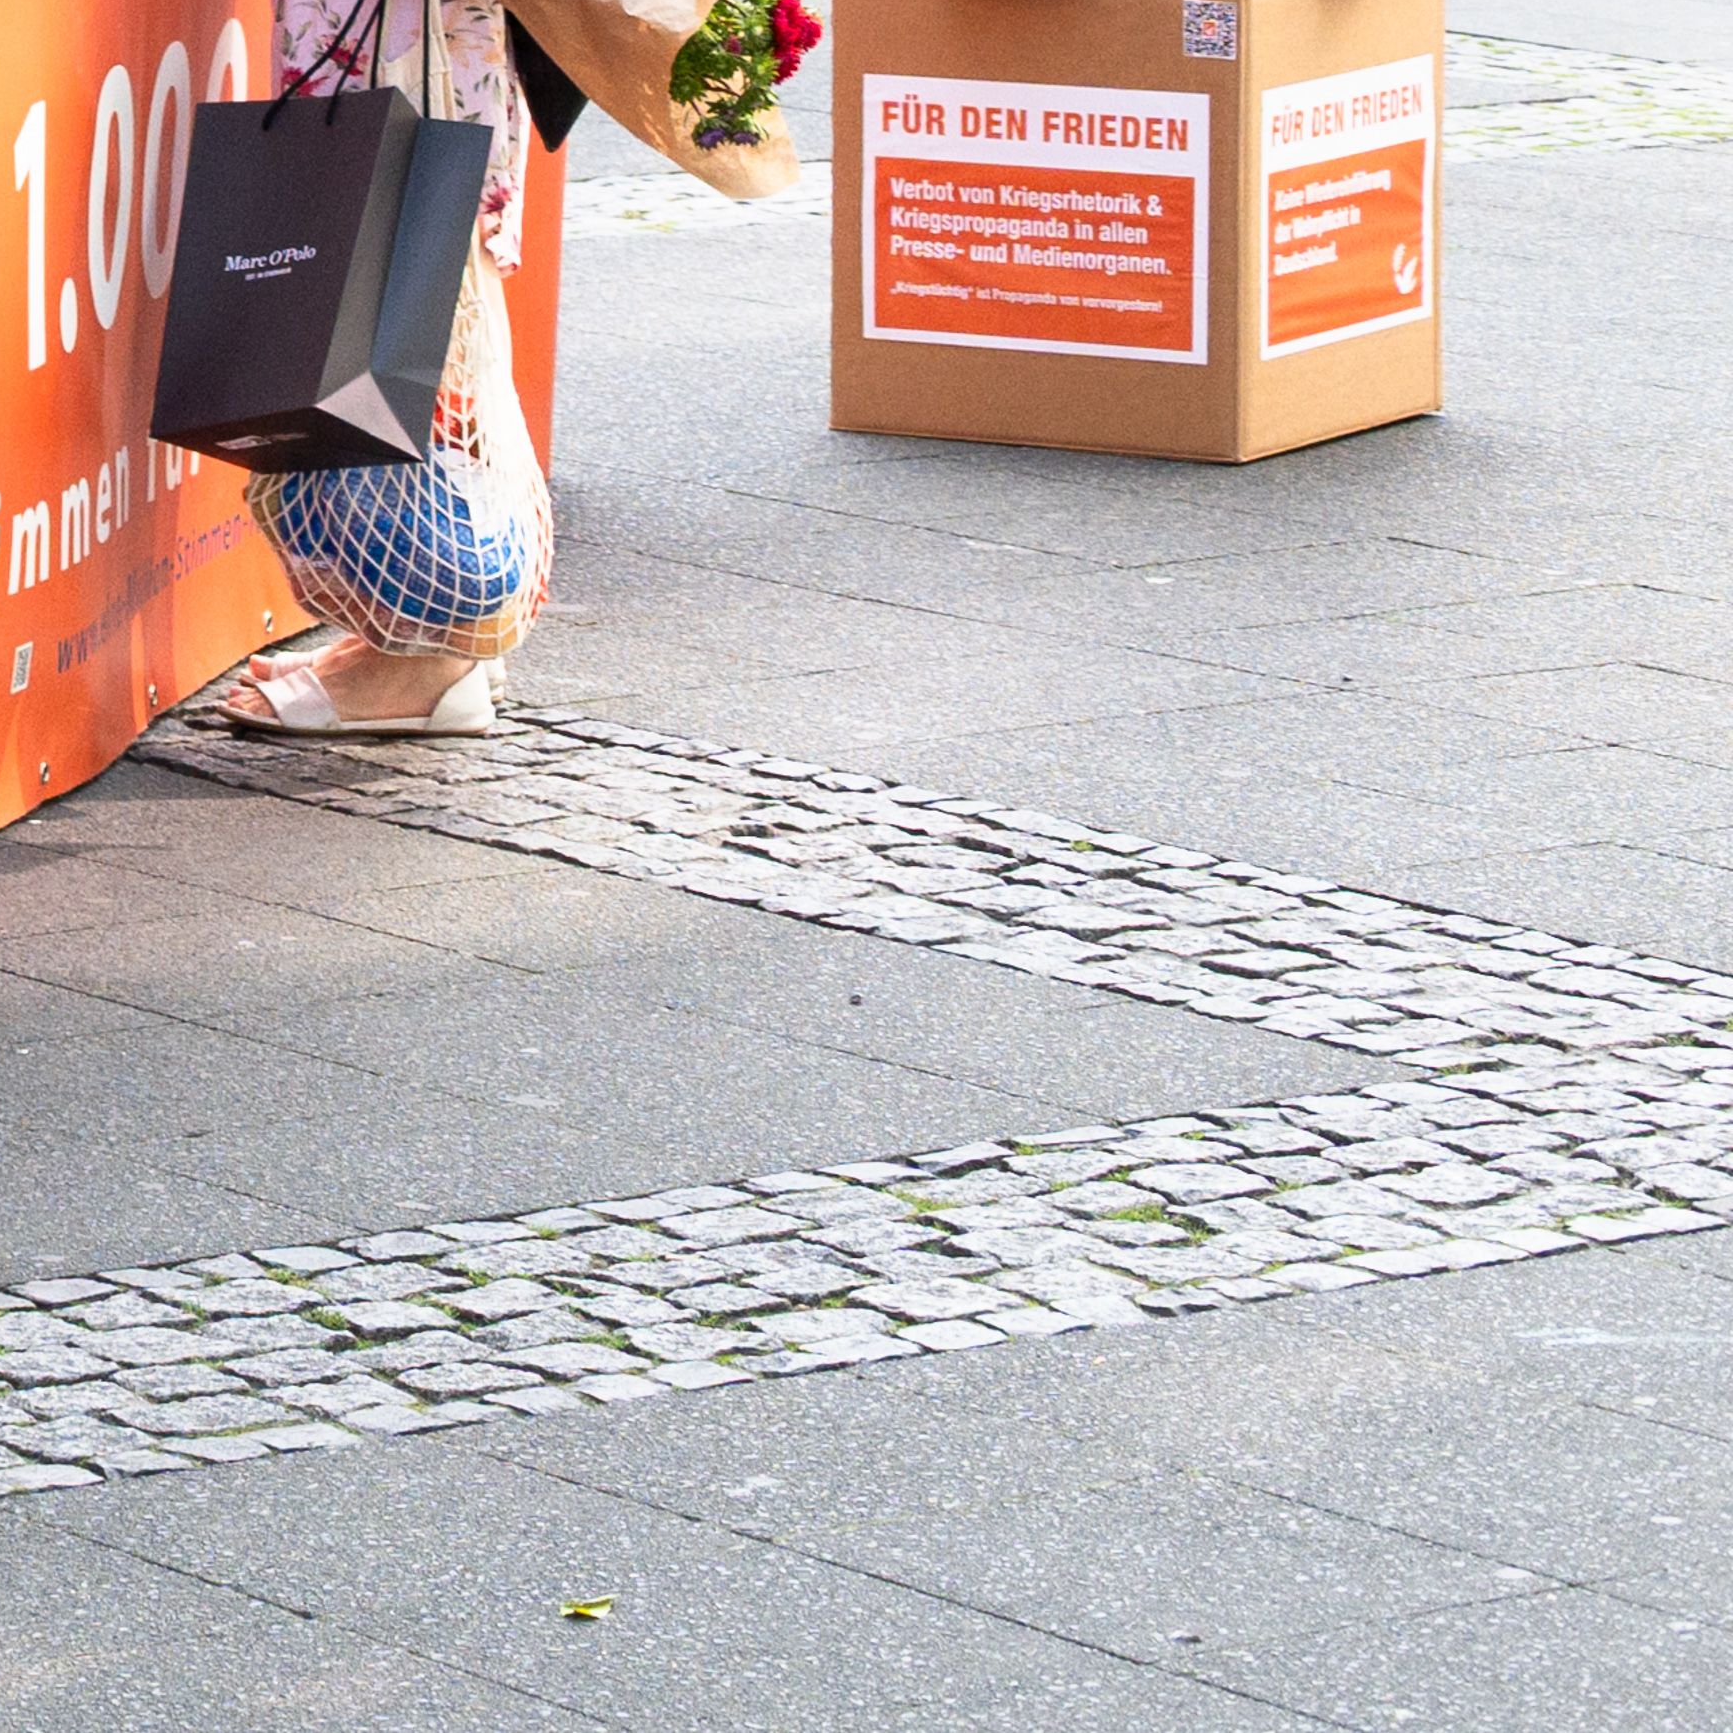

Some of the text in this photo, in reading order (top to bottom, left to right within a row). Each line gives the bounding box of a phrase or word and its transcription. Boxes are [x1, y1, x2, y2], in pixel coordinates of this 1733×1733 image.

[881, 93, 1189, 152] FÜR DEN FRIEDEN
[1272, 82, 1423, 147] FÜR DEN FRIEDEN
[890, 177, 1163, 216] Verbot von Kriegsrhetorik &
[890, 206, 1149, 245] Kriegspropaganda in allen
[224, 255, 268, 272] Marc
[890, 234, 1173, 276] Presse- und Medienorganen.
